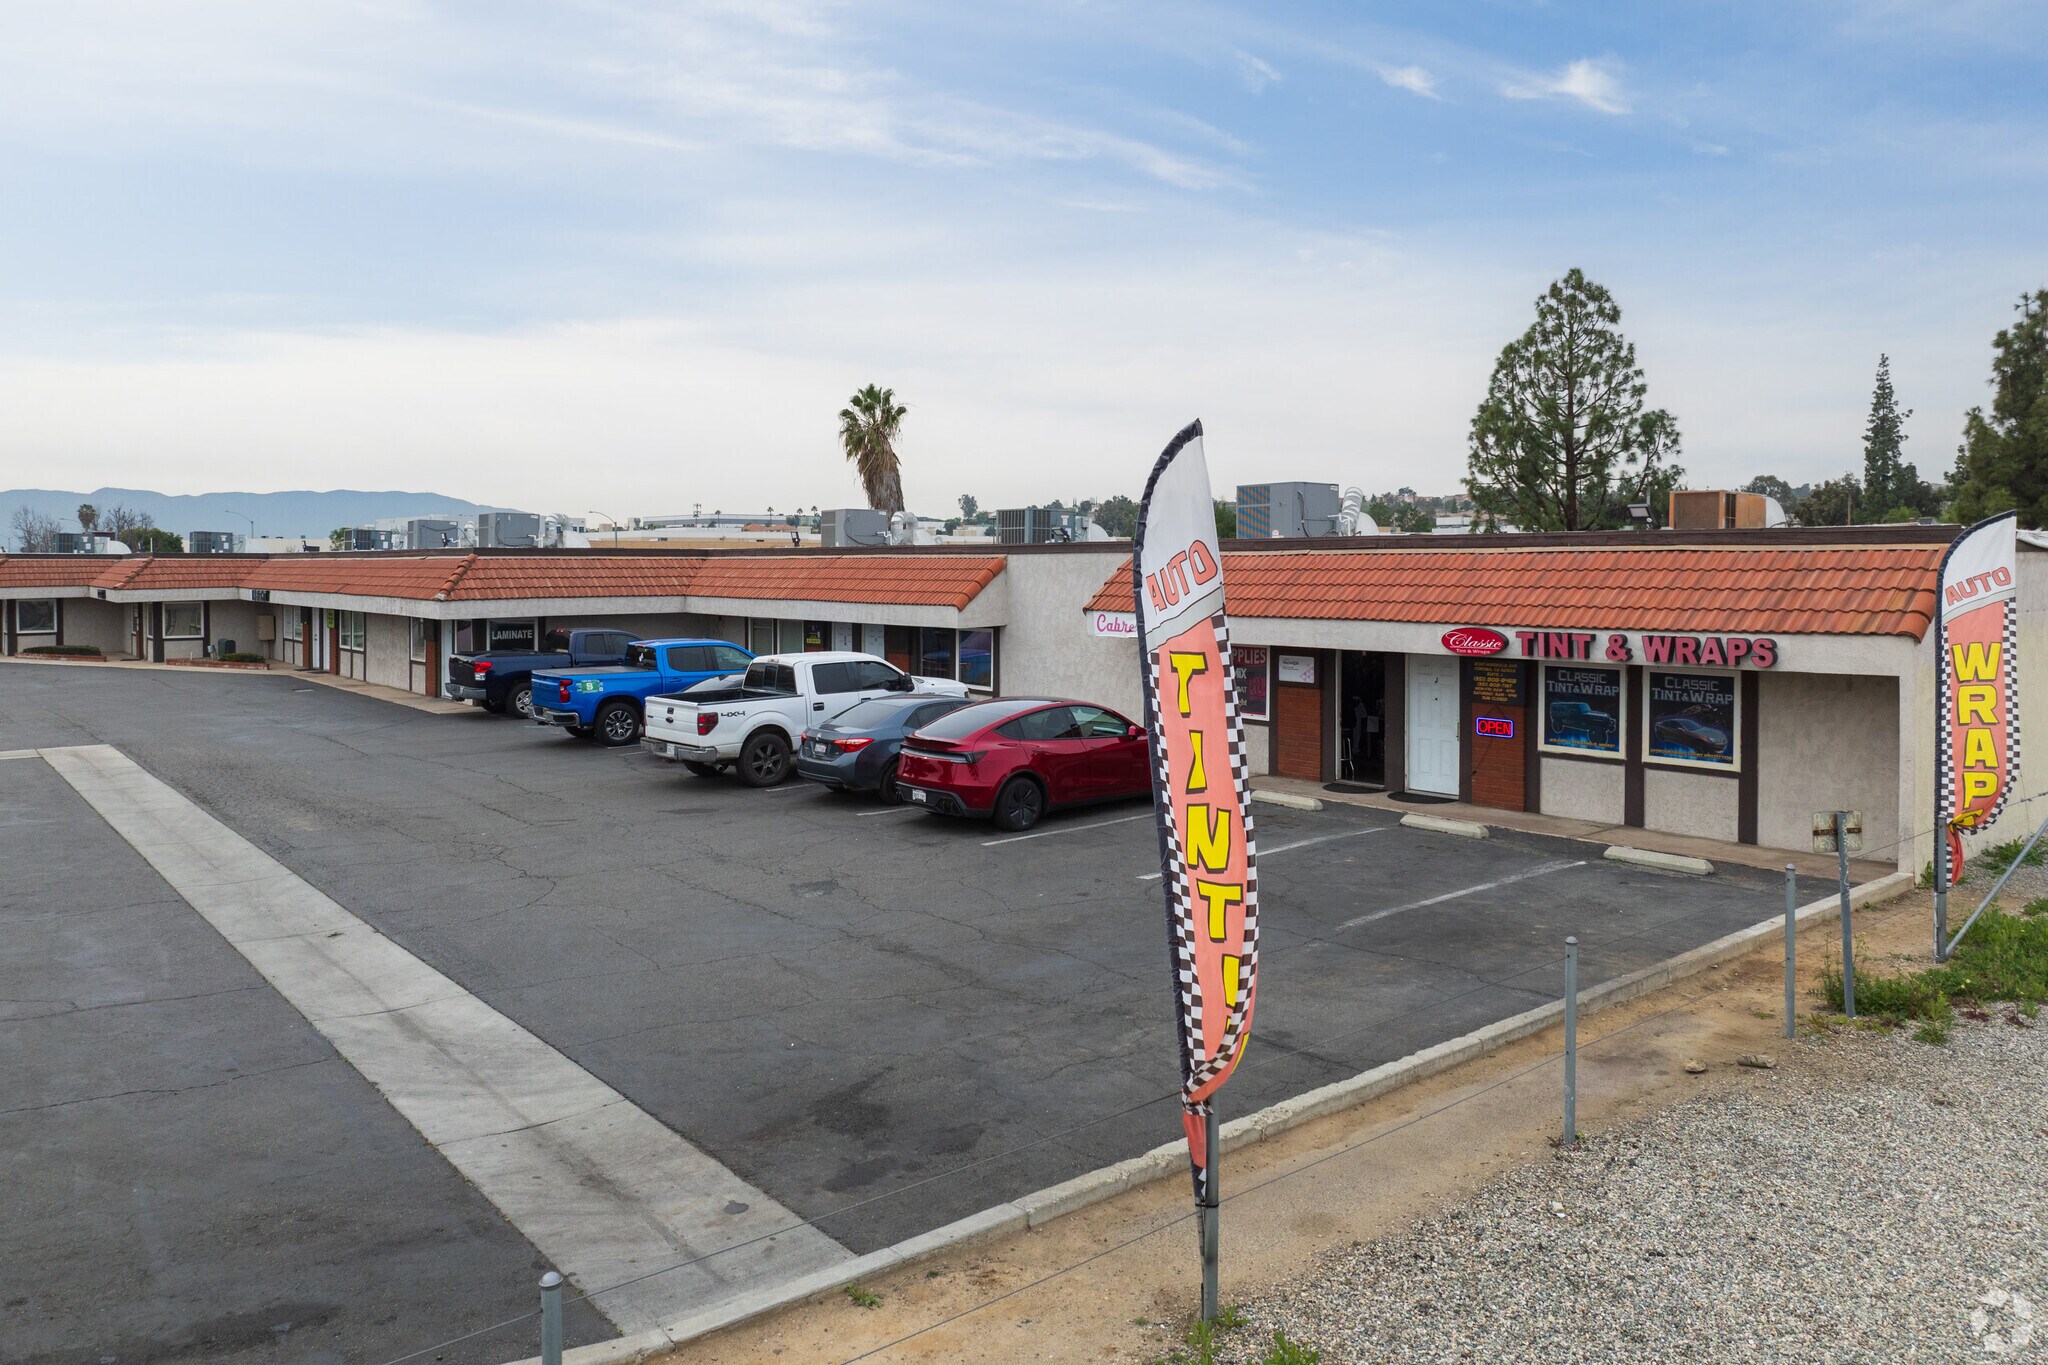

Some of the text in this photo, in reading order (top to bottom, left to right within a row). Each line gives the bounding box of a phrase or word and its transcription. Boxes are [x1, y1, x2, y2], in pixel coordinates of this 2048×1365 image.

[1145, 540, 1218, 614] AUTO
[1945, 566, 2011, 607] AUTO
[1096, 613, 1137, 633] Cabre
[492, 629, 533, 640] LAMINATE
[1445, 631, 1502, 649] Classic
[1231, 648, 1266, 665] PPLIES
[1515, 631, 1777, 668] TINT & WRAPS
[1558, 670, 1607, 684] CLASSIC
[1665, 676, 1720, 691] CLASSIC
[1479, 720, 1511, 736] OPEN
